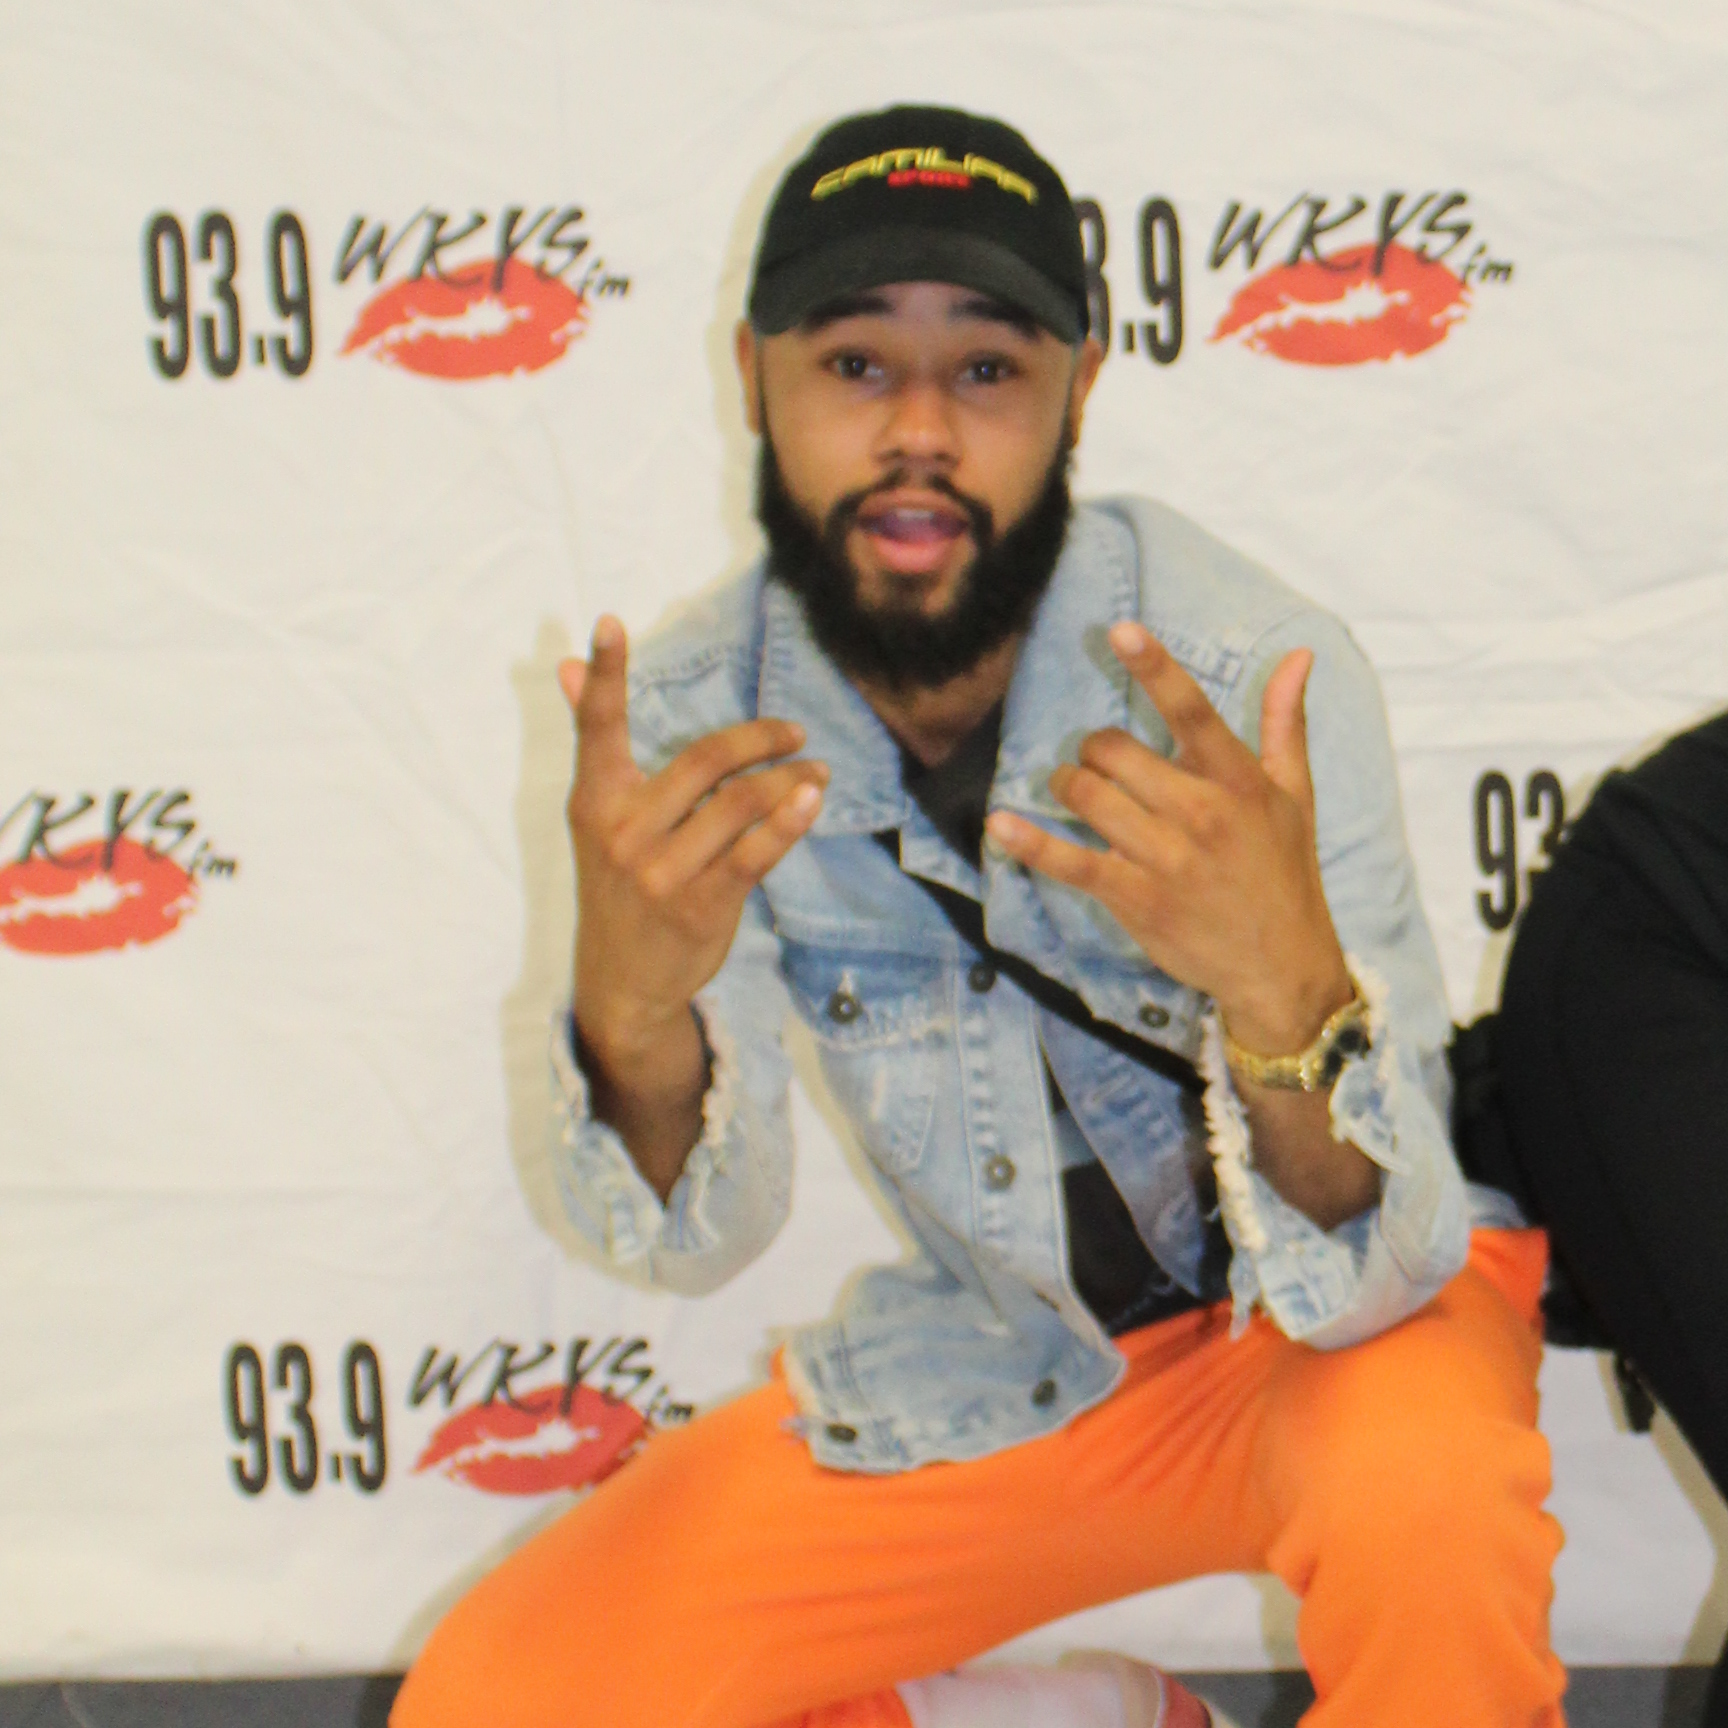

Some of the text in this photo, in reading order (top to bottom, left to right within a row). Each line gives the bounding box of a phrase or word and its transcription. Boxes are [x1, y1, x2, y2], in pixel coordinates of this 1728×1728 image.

[144, 209, 314, 381] 93.9
[335, 207, 589, 292] WKYS
[1074, 195, 1186, 366] 3.9
[1208, 191, 1476, 277] WKYS
[225, 1340, 388, 1498] 93.9
[408, 1337, 658, 1420] WKYS
